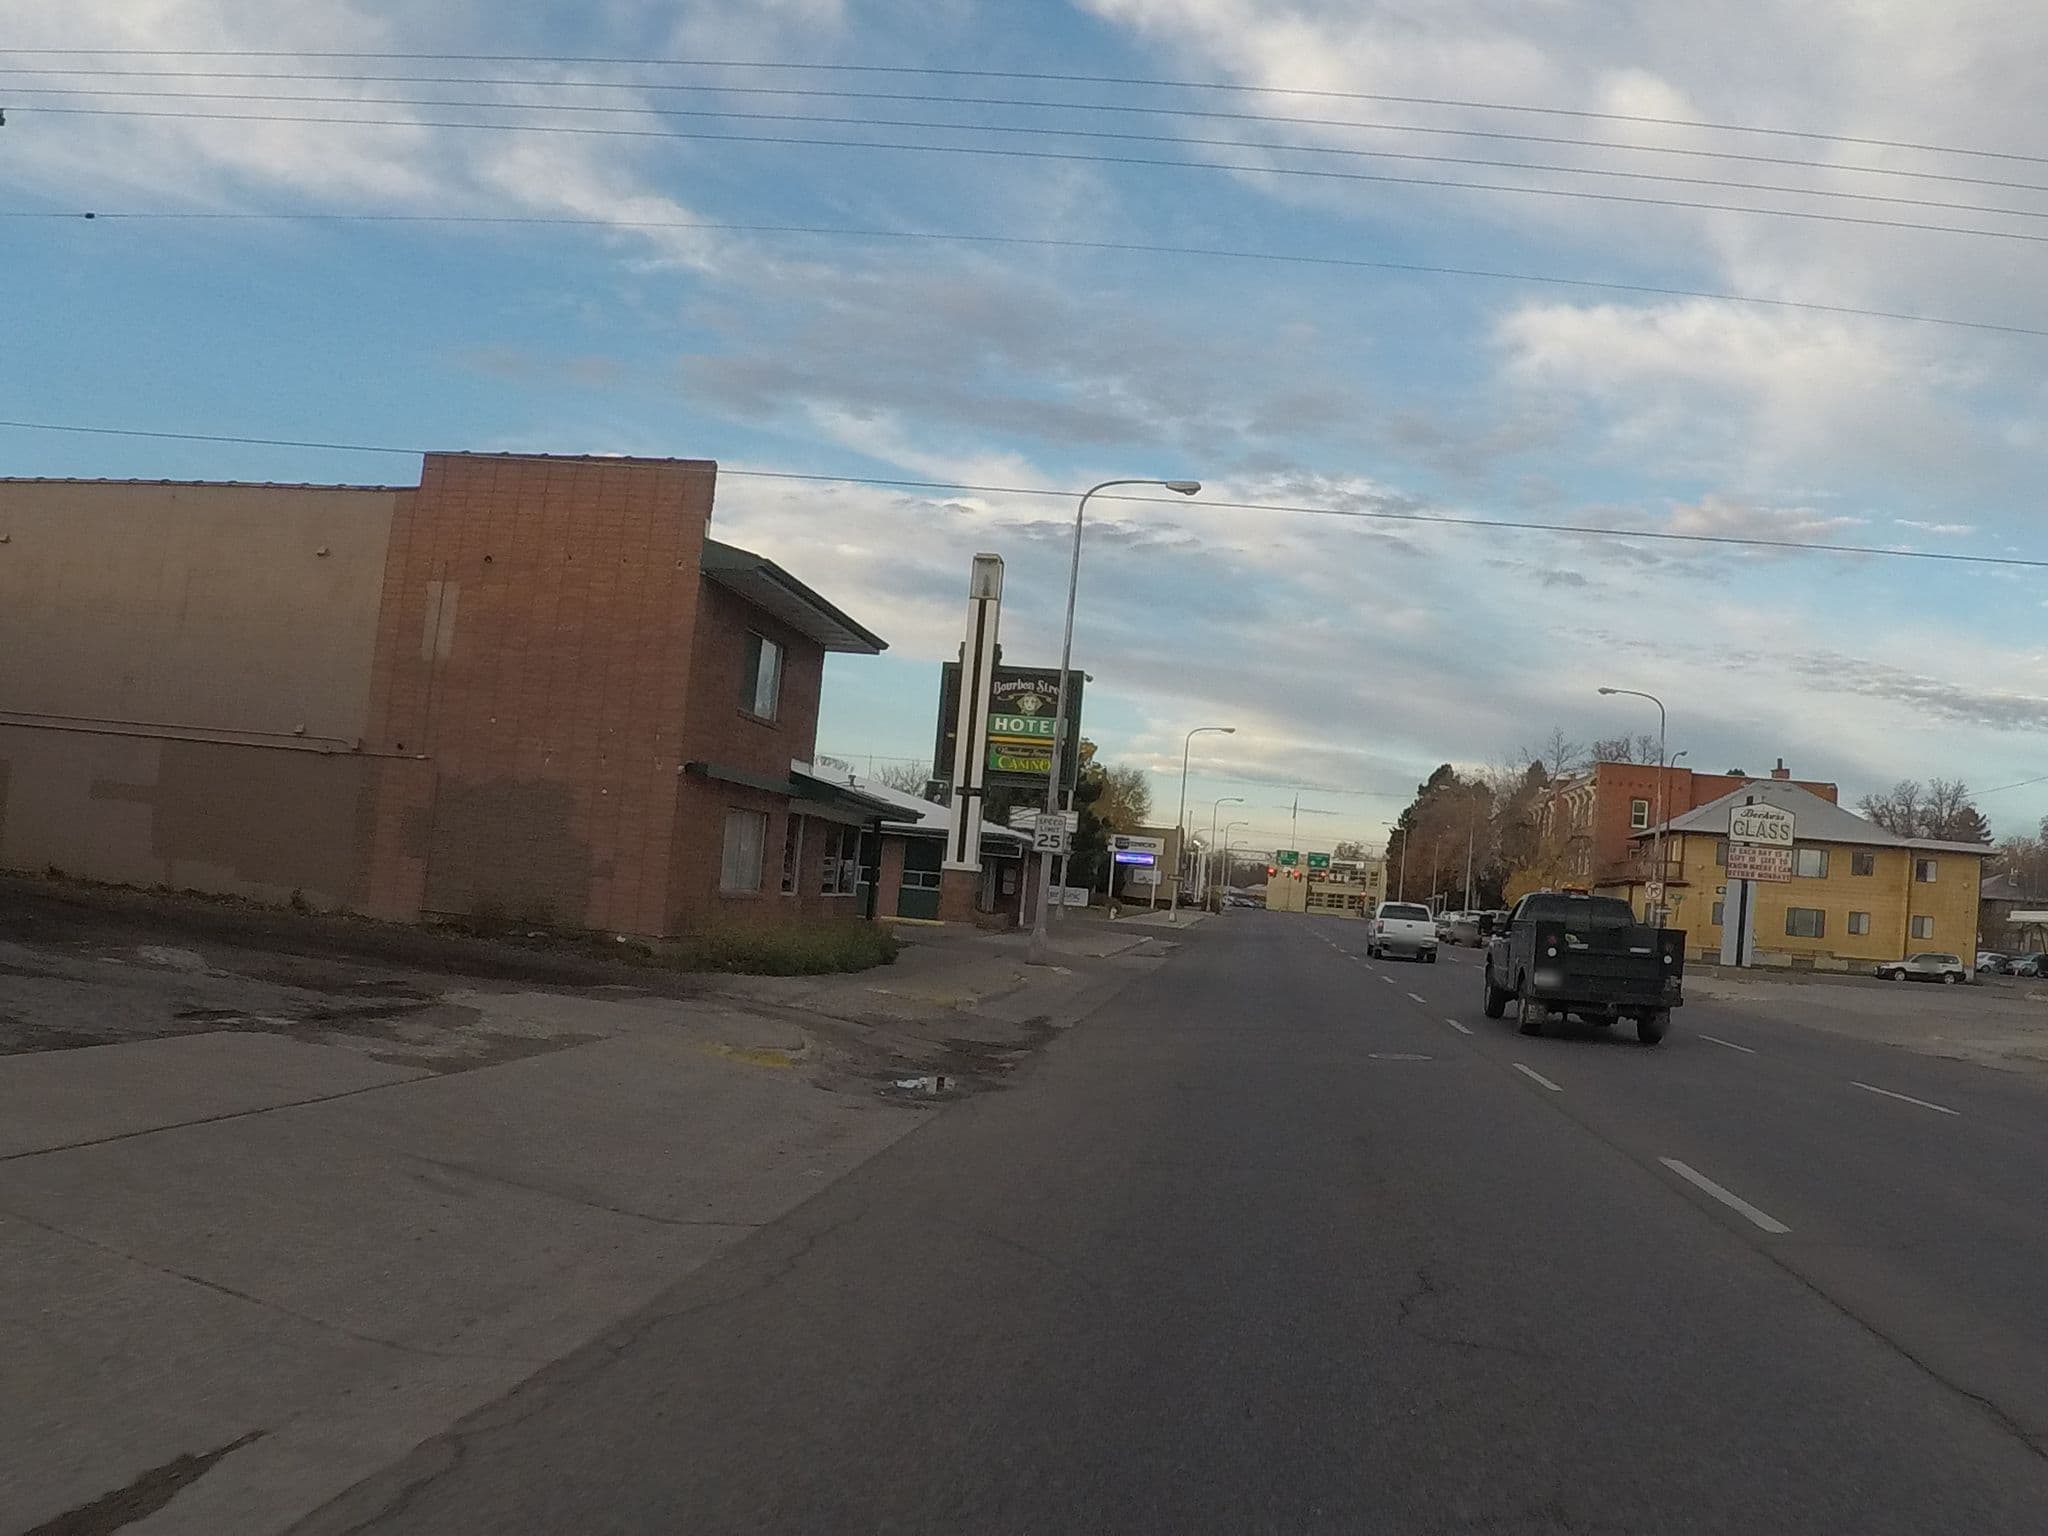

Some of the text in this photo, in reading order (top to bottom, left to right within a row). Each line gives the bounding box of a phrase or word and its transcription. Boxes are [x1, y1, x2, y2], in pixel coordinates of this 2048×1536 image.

[993, 679, 1060, 695] Bourbon Stre
[1733, 820, 1790, 840] GLASS
[1038, 834, 1061, 848] 25
